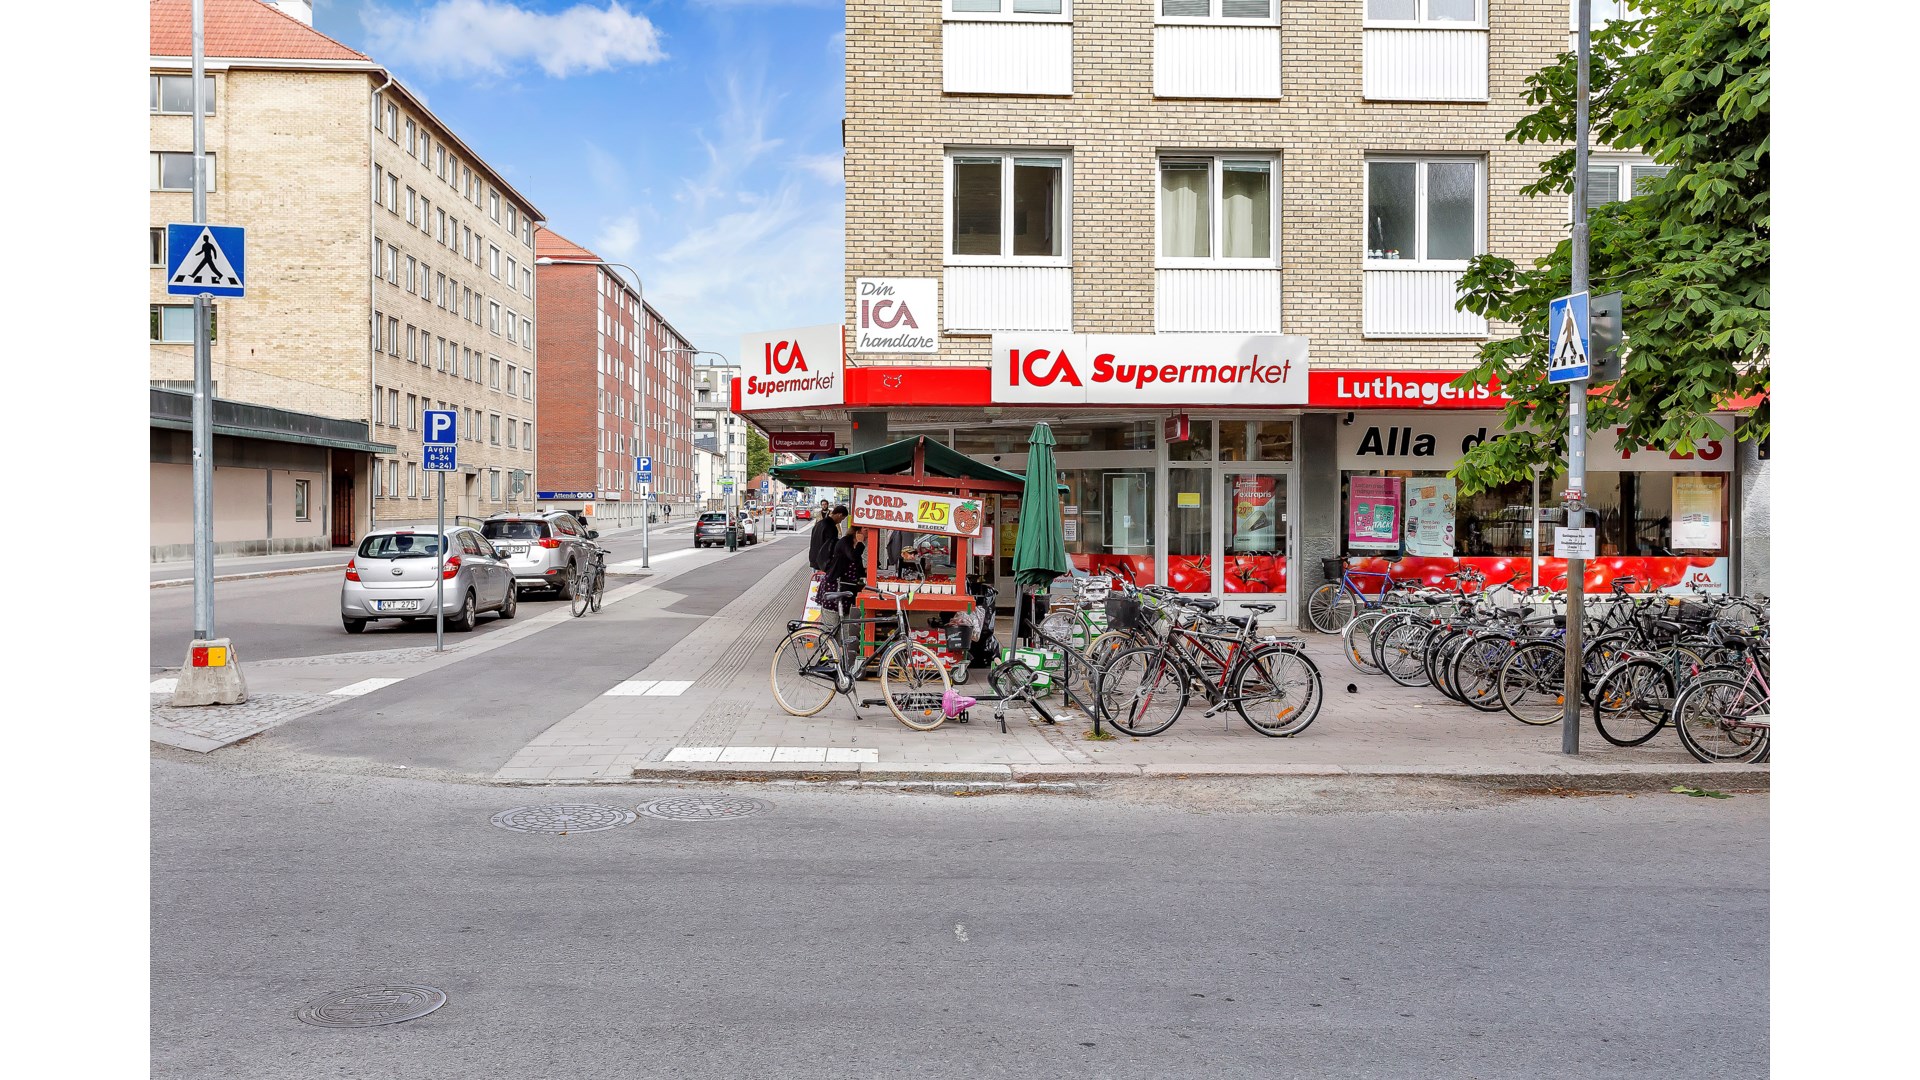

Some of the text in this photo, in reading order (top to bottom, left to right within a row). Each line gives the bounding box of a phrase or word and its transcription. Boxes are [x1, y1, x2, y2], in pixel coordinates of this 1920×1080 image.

[861, 281, 895, 296] Din
[861, 299, 919, 329] ICA
[860, 332, 934, 348] handlare
[765, 339, 808, 375] ICA
[1009, 348, 1291, 389] ICA Supermarket
[747, 370, 835, 398] Supermarket
[1337, 375, 1490, 405] Luthagens
[432, 413, 452, 441] P
[1356, 426, 1437, 456] Alla
[427, 446, 453, 454] Avgift
[640, 457, 650, 471] P
[864, 494, 908, 508] JORD-
[1239, 490, 1272, 499] extrapris
[854, 507, 915, 523] GUBBAR
[1685, 581, 1722, 589] Suermarket
[1693, 573, 1711, 582] ICA
[401, 600, 416, 608] 275
